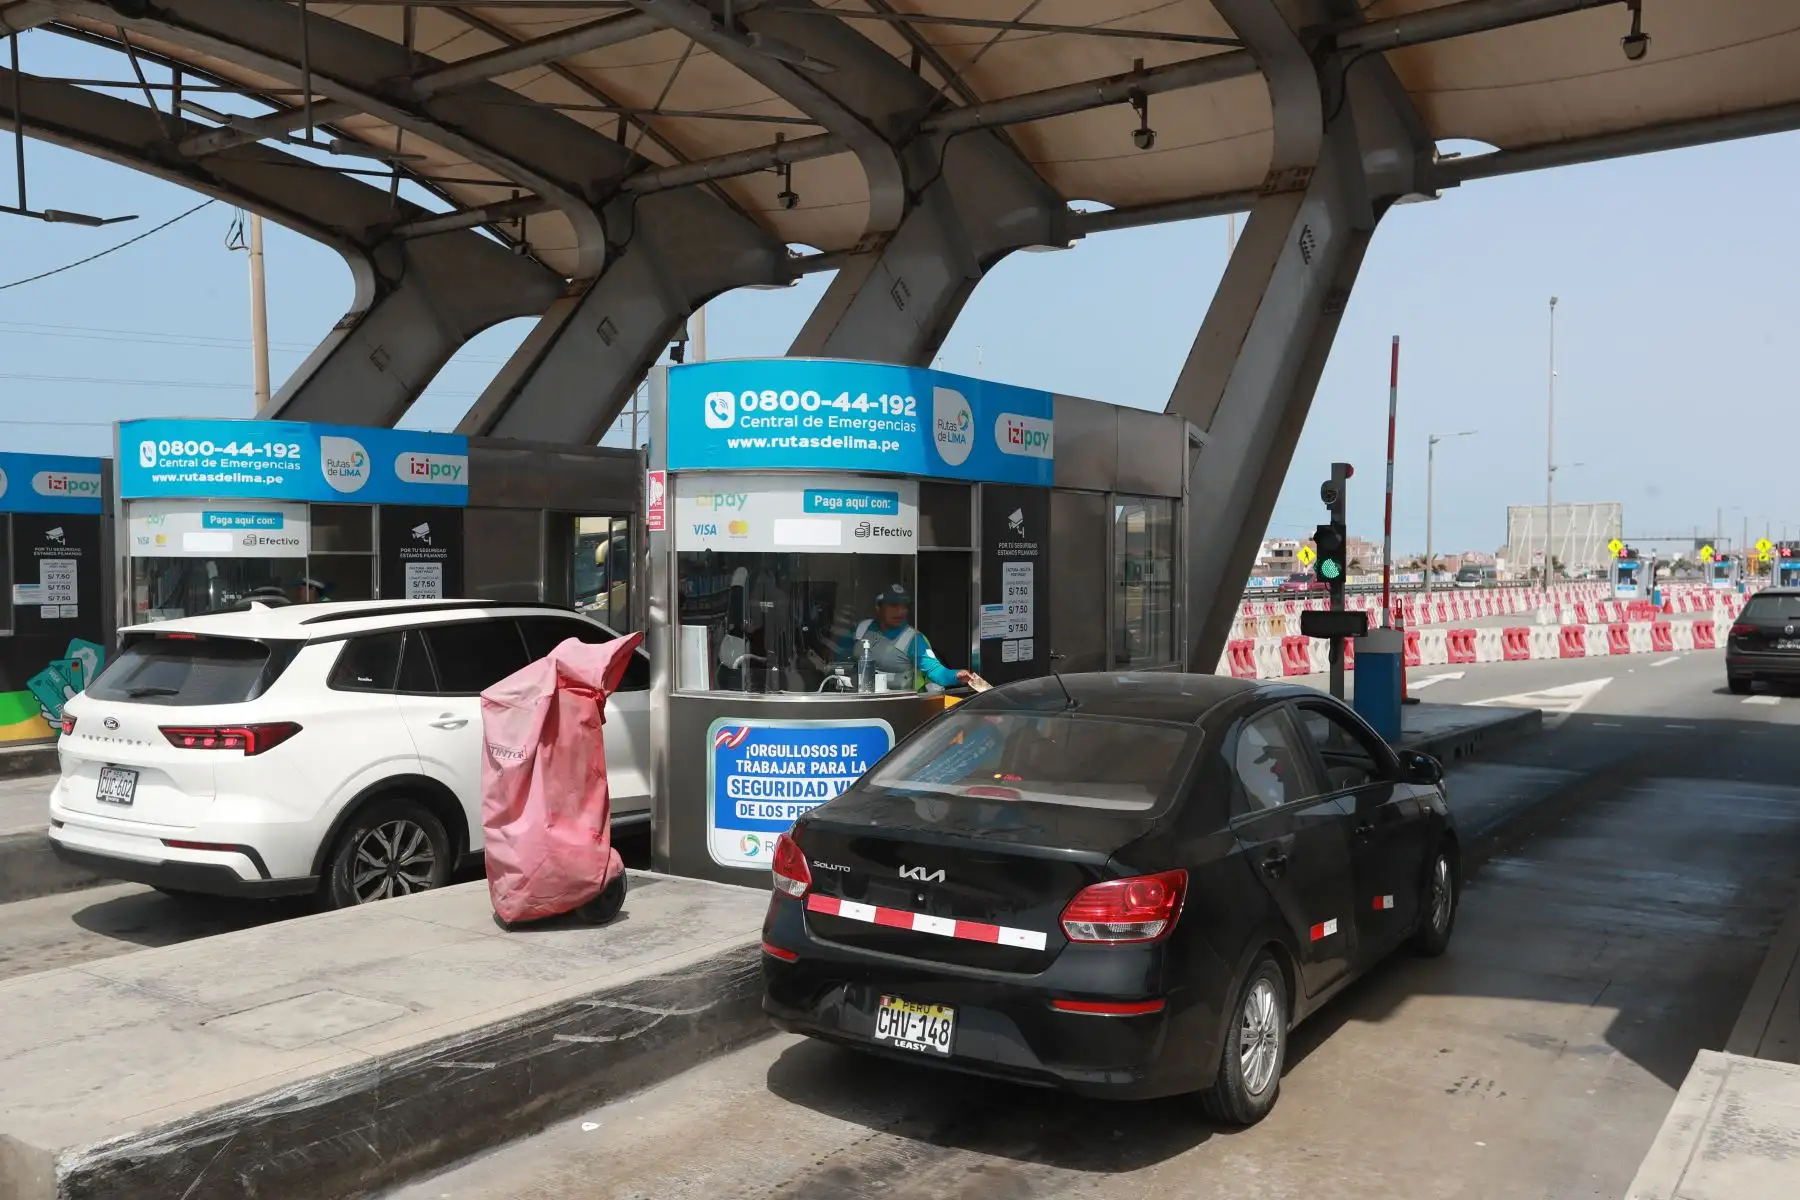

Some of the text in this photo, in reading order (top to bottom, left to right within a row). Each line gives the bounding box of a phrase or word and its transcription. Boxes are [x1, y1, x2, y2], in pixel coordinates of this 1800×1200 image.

[740, 390, 917, 417] 0800-44-192
[740, 415, 917, 433] Central de Emergencias
[937, 419, 957, 432] Rutas
[937, 432, 966, 445] de LIMA
[1008, 420, 1050, 452] izipay
[158, 440, 301, 459] 0800-44-192
[727, 435, 900, 452] www.rutasdelima.pe
[159, 458, 301, 471] Central de Emergencias
[327, 459, 350, 469] Rutas
[410, 457, 462, 480] izipay
[151, 472, 284, 486] www.rutasdelima.pe
[327, 468, 361, 478] de LIMA
[48, 475, 100, 494] izipay
[814, 495, 891, 511] Paga aquí con:
[210, 514, 276, 526] Paga aquí con:
[692, 524, 717, 536] VISA
[873, 526, 913, 537] Efectivo
[258, 537, 300, 546] Efectivo
[746, 743, 858, 759] ¡ORGULLOSOS DE
[736, 759, 867, 774] TRABAJAR PARA LA
[731, 778, 828, 798] SEGURIDAD
[740, 803, 755, 816] DE
[758, 804, 783, 817] LOS
[899, 864, 946, 883] KIA
[902, 1002, 931, 1014] PERU
[878, 1006, 950, 1046] CHV-148
[894, 1039, 927, 1052] LEASY
